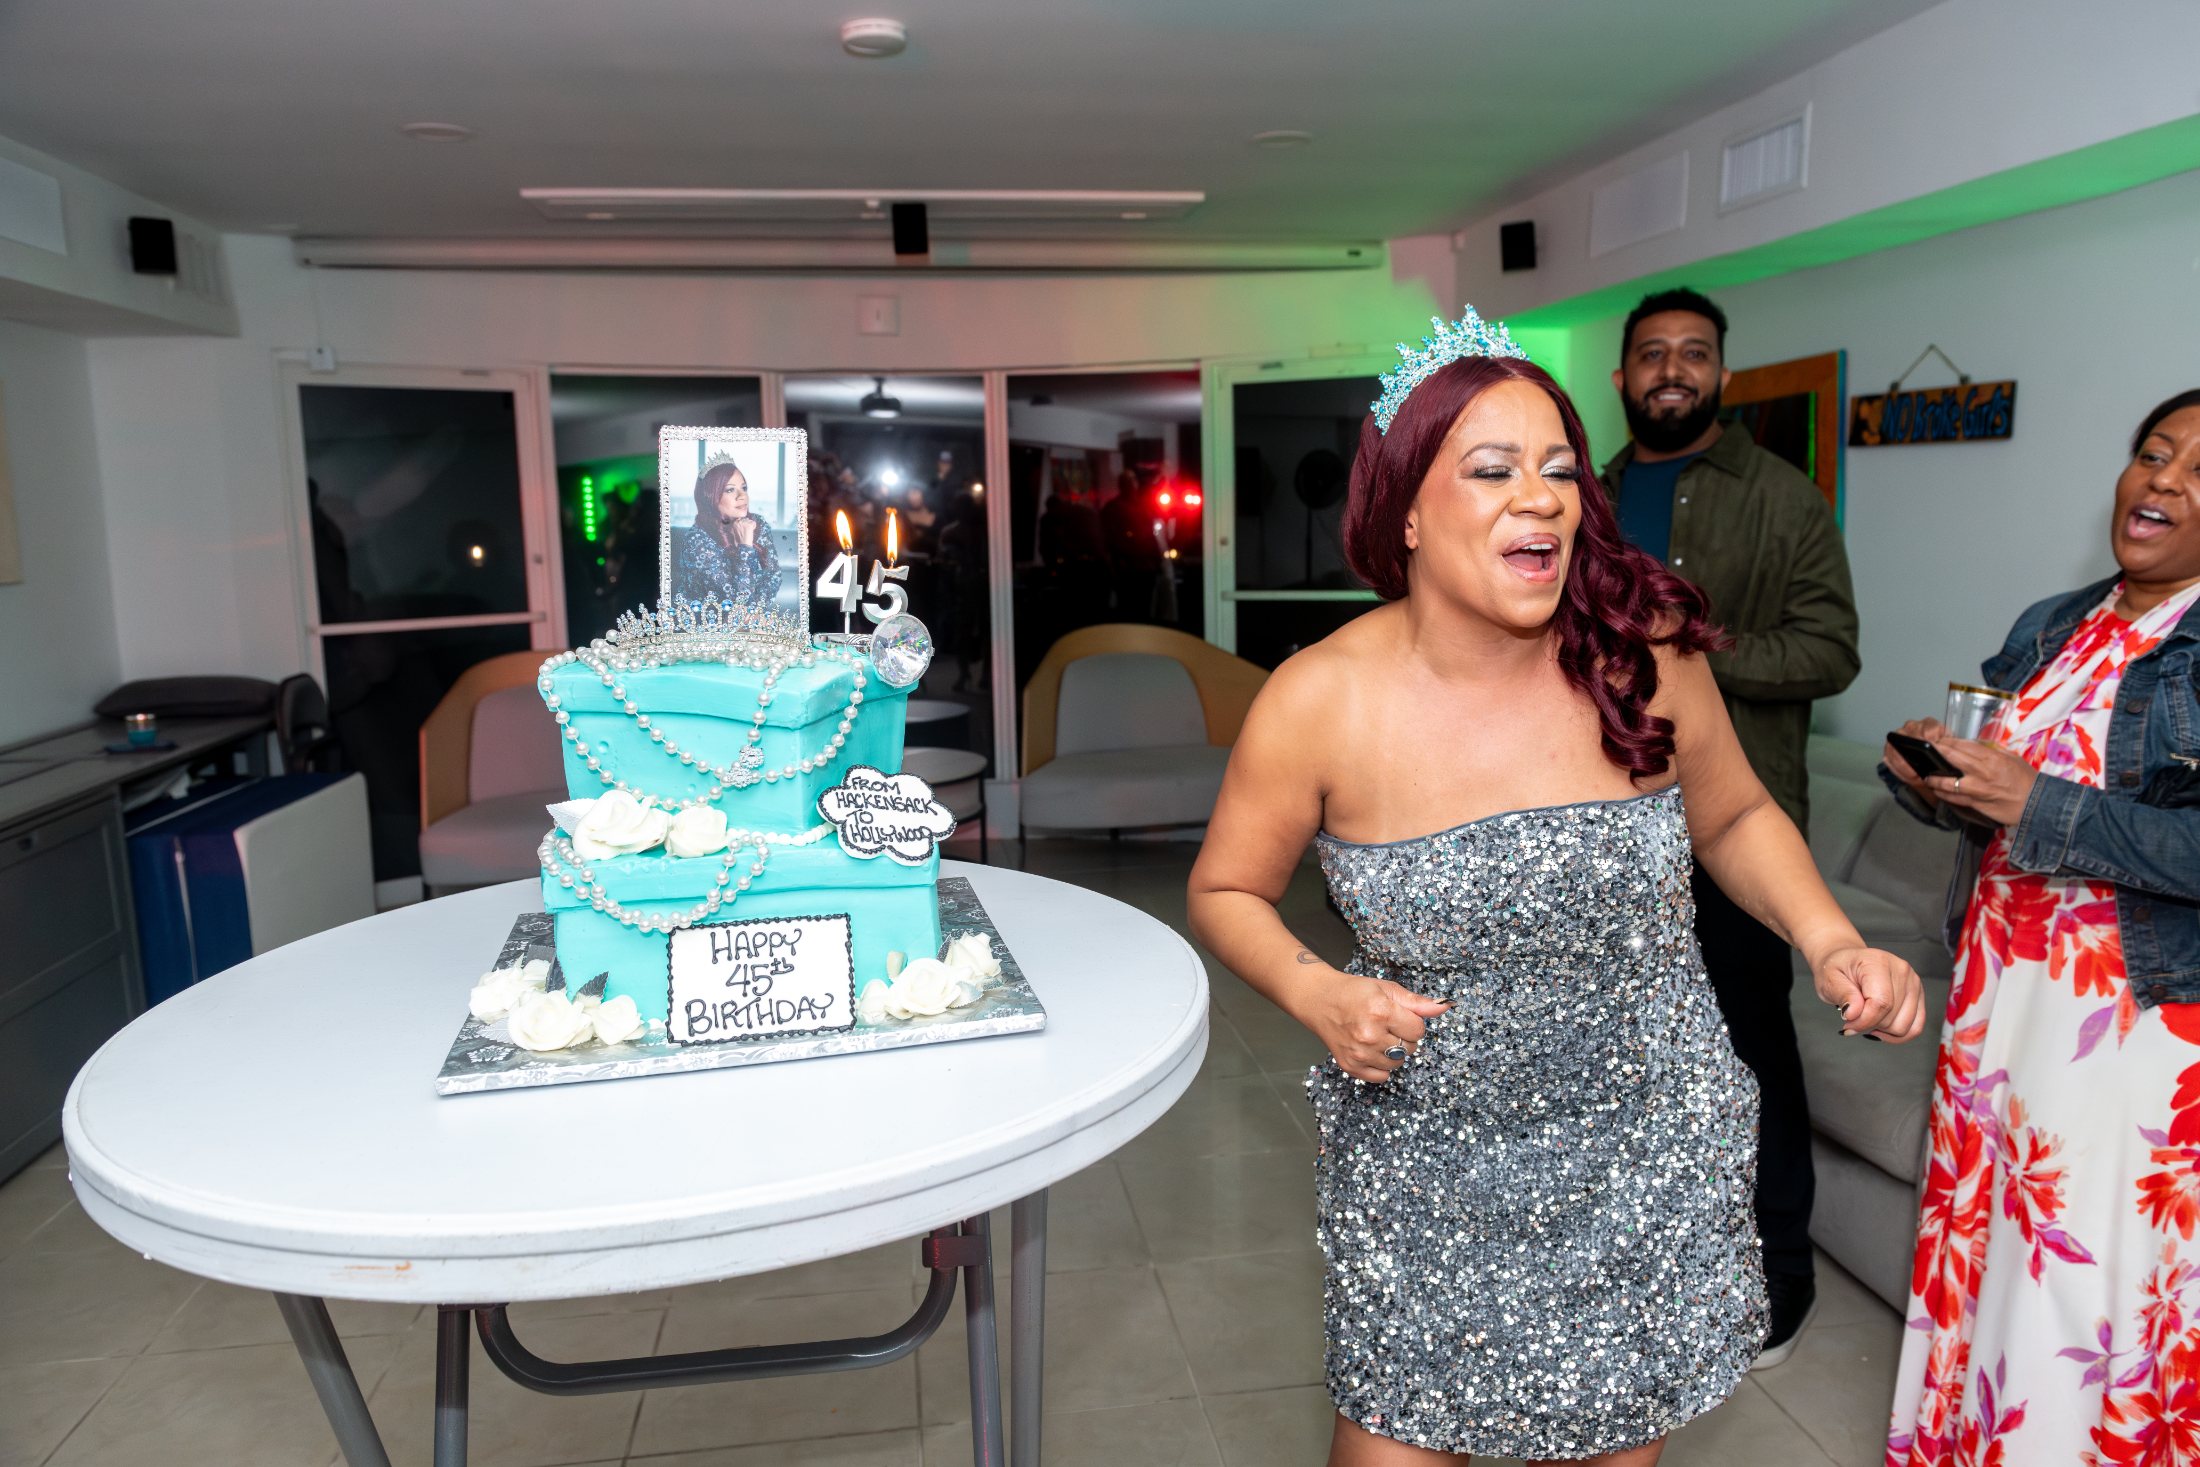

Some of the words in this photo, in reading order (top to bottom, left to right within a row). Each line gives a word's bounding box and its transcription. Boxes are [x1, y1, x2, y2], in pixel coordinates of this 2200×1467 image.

[1881, 393, 1912, 441] NO
[816, 552, 909, 625] 45
[851, 776, 901, 794] FROM
[836, 792, 938, 816] HACKENSACK
[846, 809, 874, 824] TO
[850, 824, 933, 844] HOLLYWOOD
[710, 928, 802, 964] HAPPY
[725, 957, 794, 997] 45th
[685, 993, 834, 1037] BIRTHDAY
